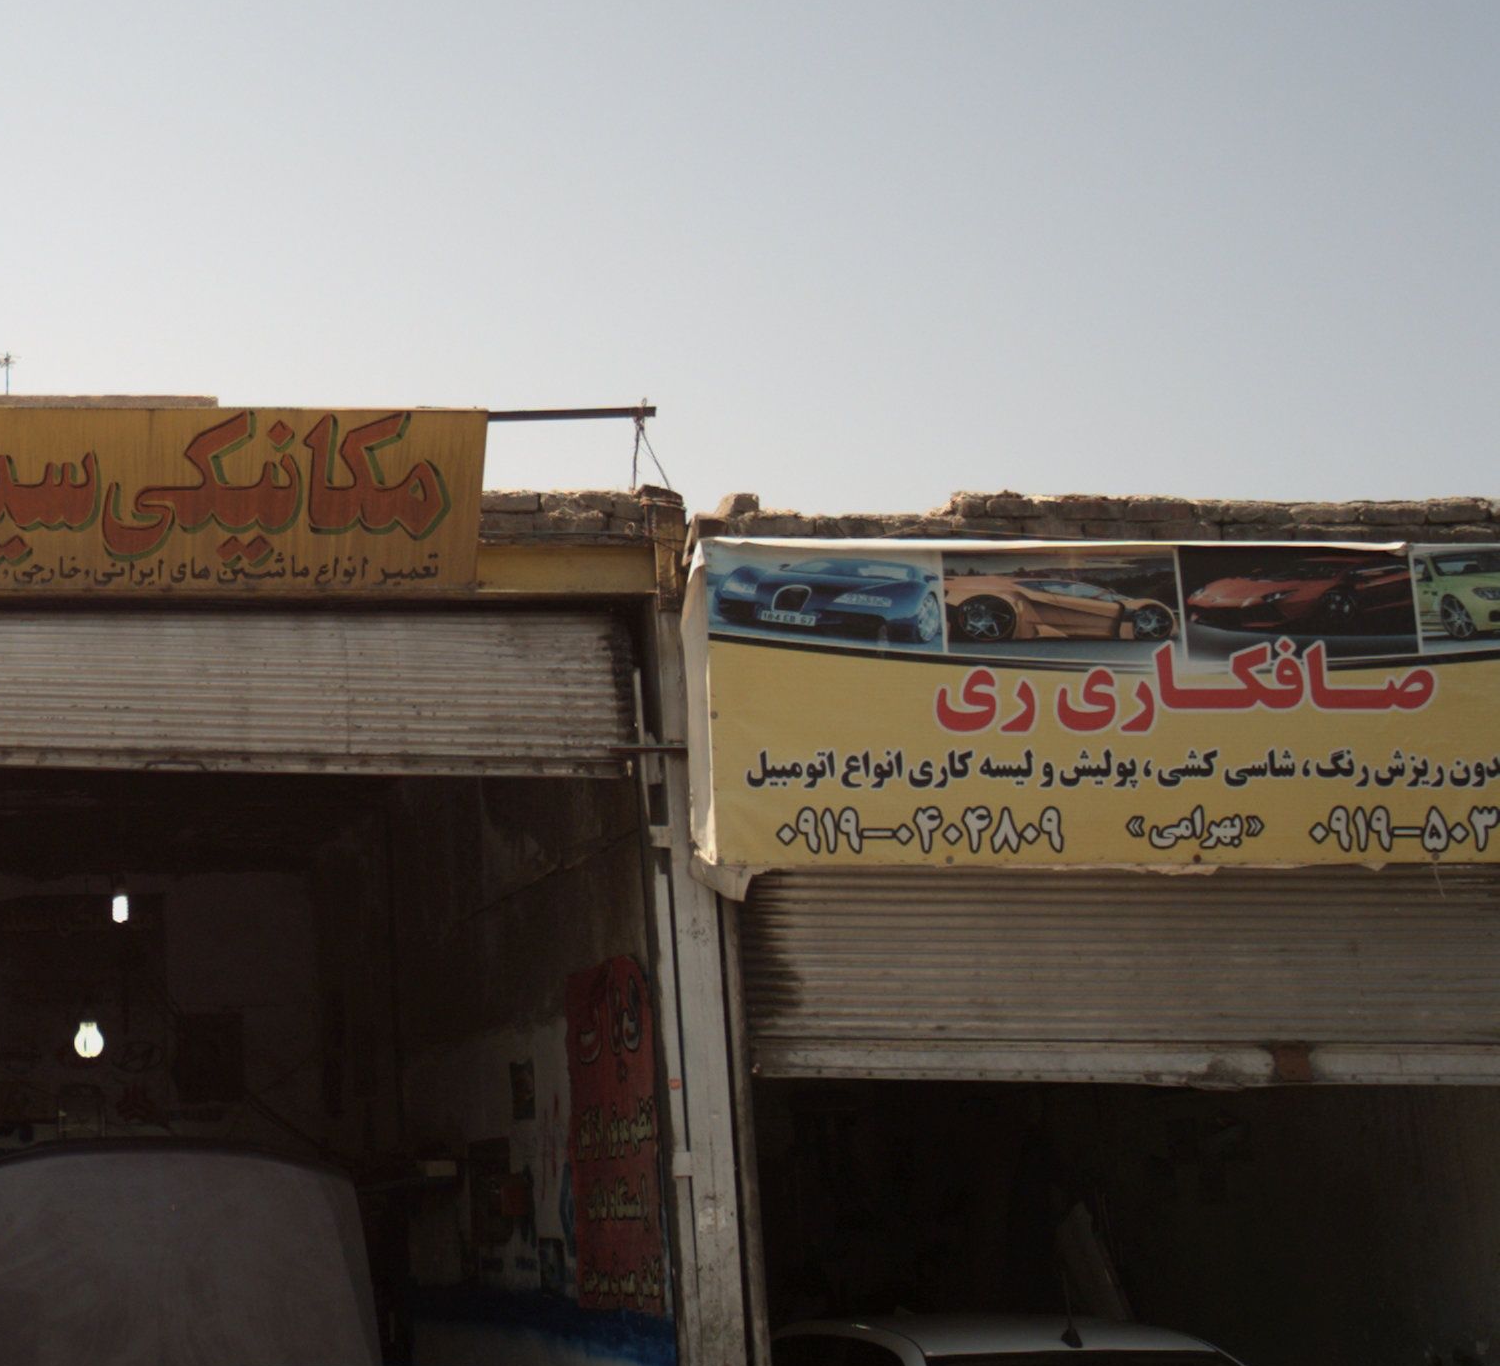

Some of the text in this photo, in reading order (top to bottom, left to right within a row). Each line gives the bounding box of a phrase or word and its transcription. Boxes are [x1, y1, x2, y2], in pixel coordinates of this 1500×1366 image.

[101, 410, 451, 567] مکانیکی
[13, 555, 82, 584] خارجی
[93, 558, 165, 584] ایرانی
[170, 556, 211, 583] های
[216, 551, 310, 584] ماشین
[314, 555, 369, 585] انواع
[373, 552, 441, 585] تعمیر
[934, 637, 1438, 734] صافکاری ری
[746, 749, 836, 788] اتومبیل
[841, 749, 903, 788] انواع
[908, 750, 973, 788] کاری
[979, 748, 1034, 786] لیسه
[1041, 762, 1054, 787] و
[1059, 749, 1139, 789] پولیش
[1224, 749, 1296, 787] شاسی
[1374, 749, 1445, 788] ریزش
[1449, 755, 1500, 788] دون
[1308, 804, 1500, 854] ۰۹۱۹-۵۰۳
